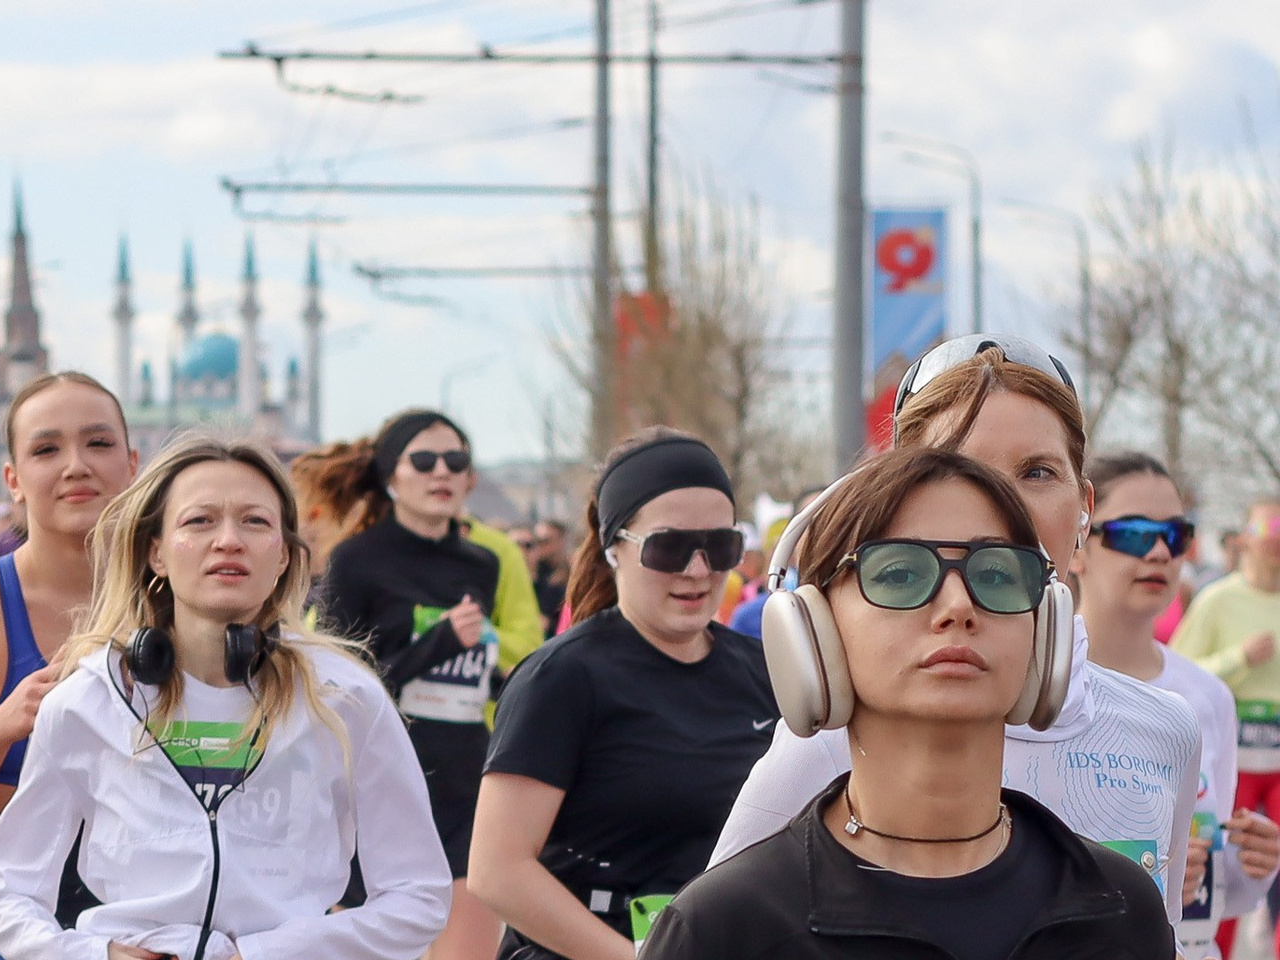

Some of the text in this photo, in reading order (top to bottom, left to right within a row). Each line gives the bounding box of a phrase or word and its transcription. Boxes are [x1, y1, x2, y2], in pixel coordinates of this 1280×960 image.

[1067, 752, 1172, 781] IDS BORJOMI
[1096, 773, 1163, 796] Pro Sport
